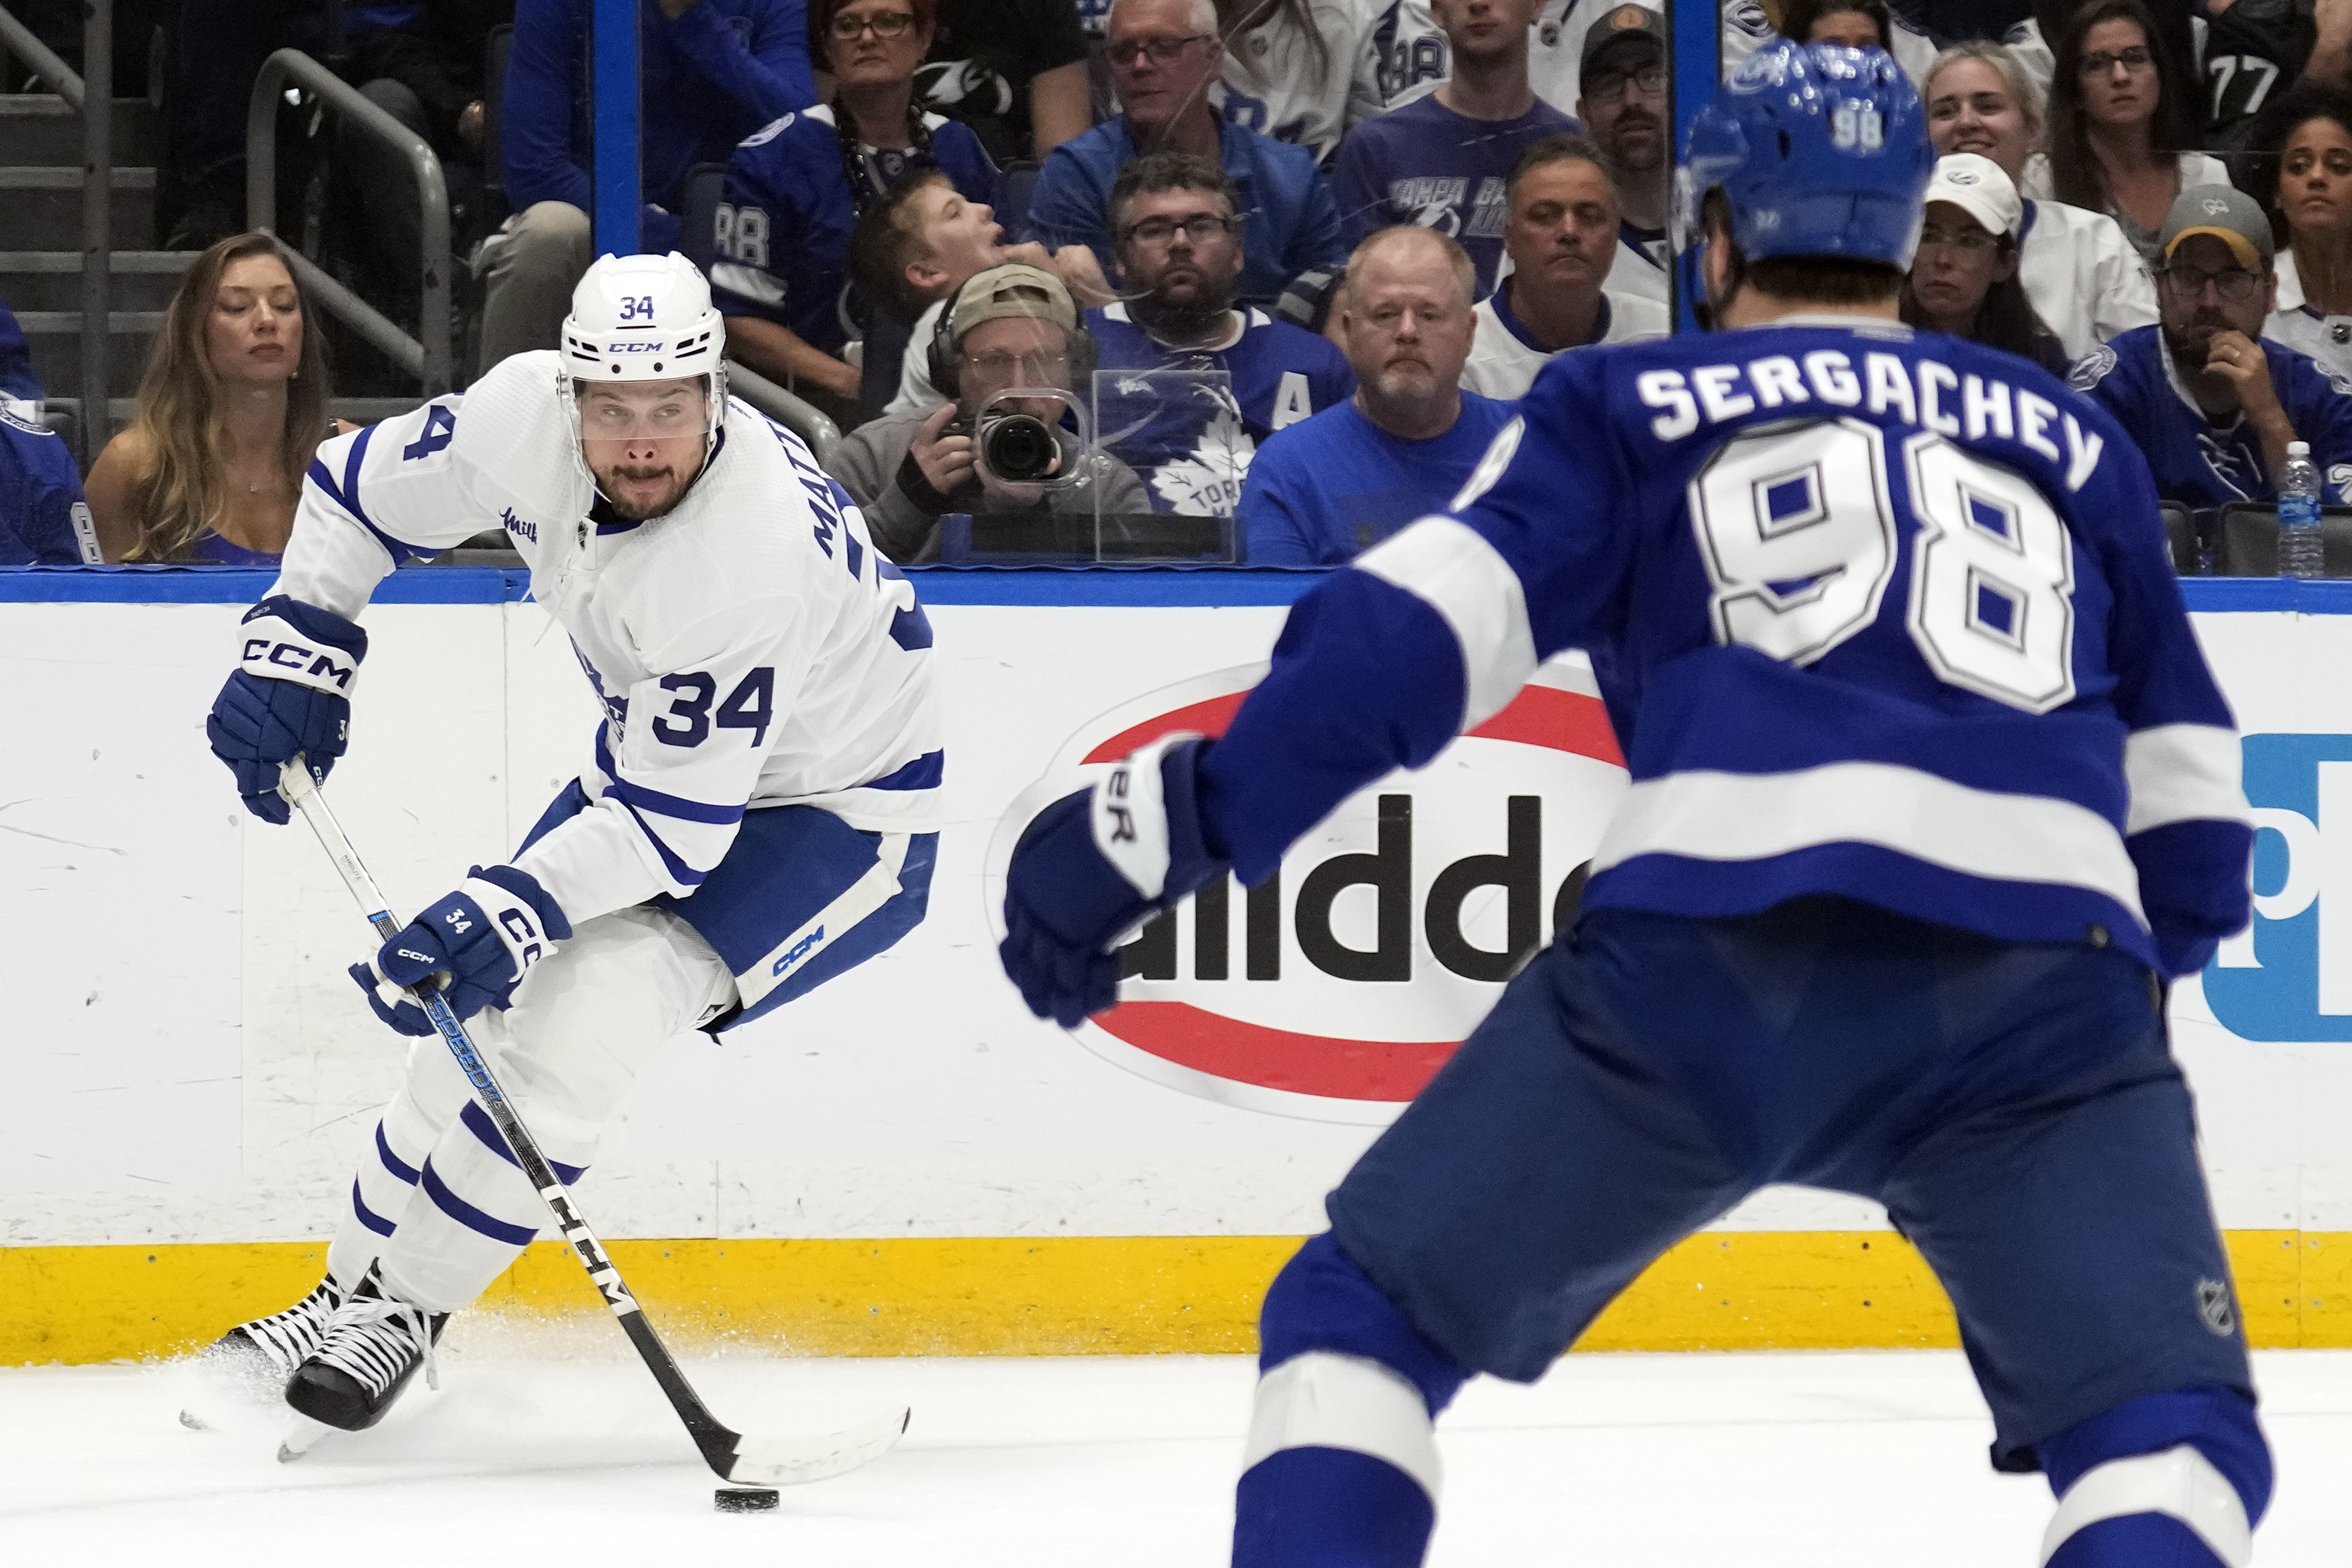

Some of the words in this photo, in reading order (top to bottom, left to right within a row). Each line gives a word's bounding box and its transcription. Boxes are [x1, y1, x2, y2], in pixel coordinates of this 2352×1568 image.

[2209, 55, 2280, 120] 77
[1832, 108, 1883, 148] 98
[620, 296, 654, 319] 34
[609, 342, 664, 352] CCM
[1272, 371, 1312, 430] A
[759, 412, 838, 560] MATT
[1189, 478, 1246, 508] TOR
[1688, 417, 2075, 714] 98
[243, 639, 353, 689] CCM
[652, 667, 775, 748] 34
[446, 908, 472, 934] 34
[498, 908, 542, 969] CC
[398, 949, 435, 964] CCM
[773, 925, 825, 977] CCM
[426, 992, 492, 1088] SPEED
[540, 1183, 641, 1317] CCM
